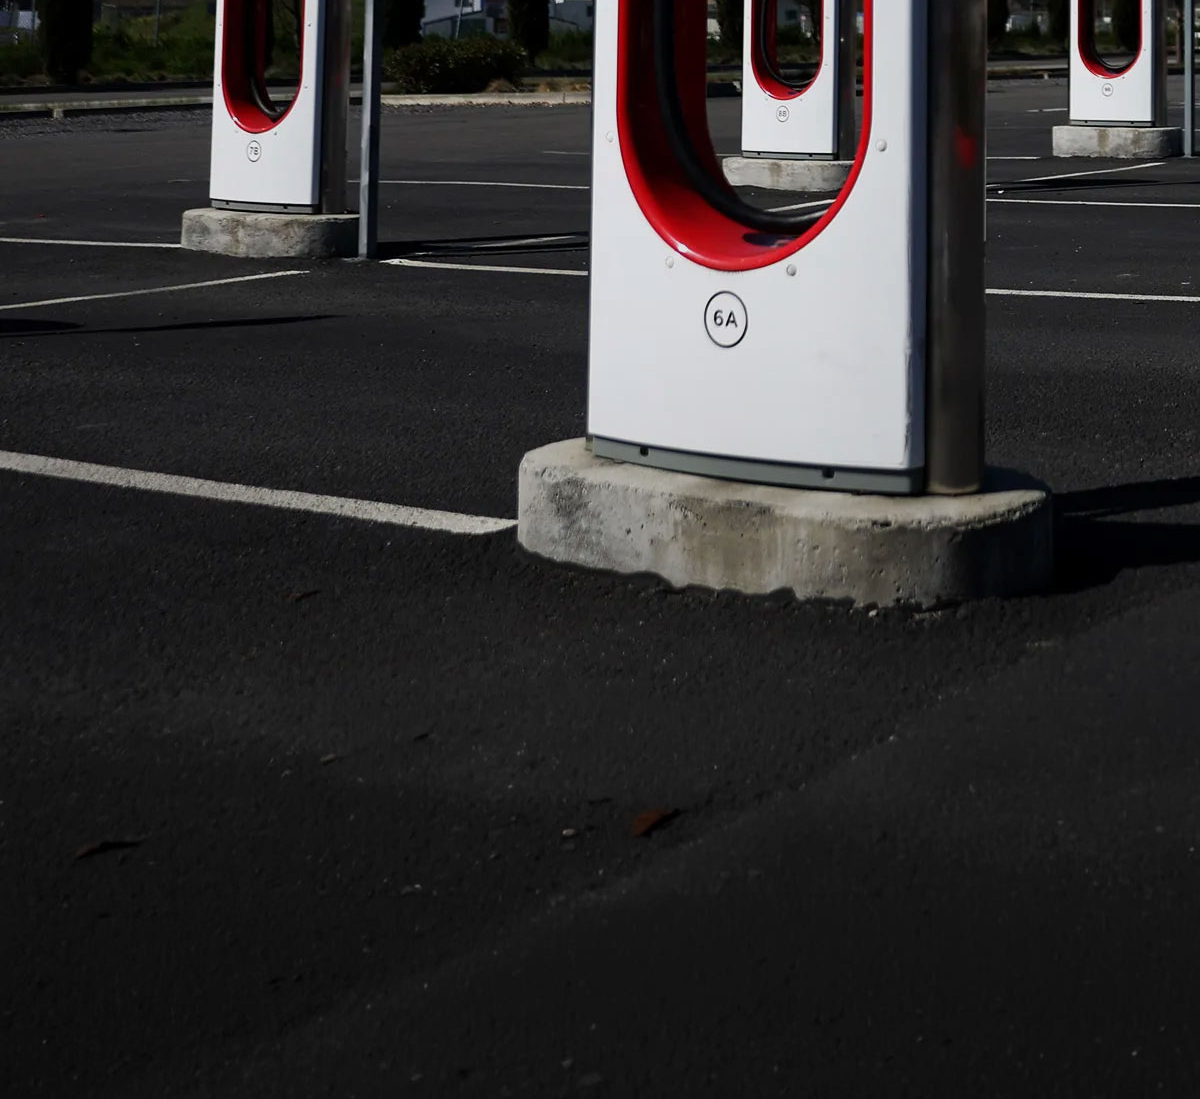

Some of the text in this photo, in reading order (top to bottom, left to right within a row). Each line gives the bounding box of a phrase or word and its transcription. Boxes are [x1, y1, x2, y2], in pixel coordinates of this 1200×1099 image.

[778, 110, 787, 118] 8B
[249, 146, 259, 156] 7B
[713, 310, 738, 328] 6A
